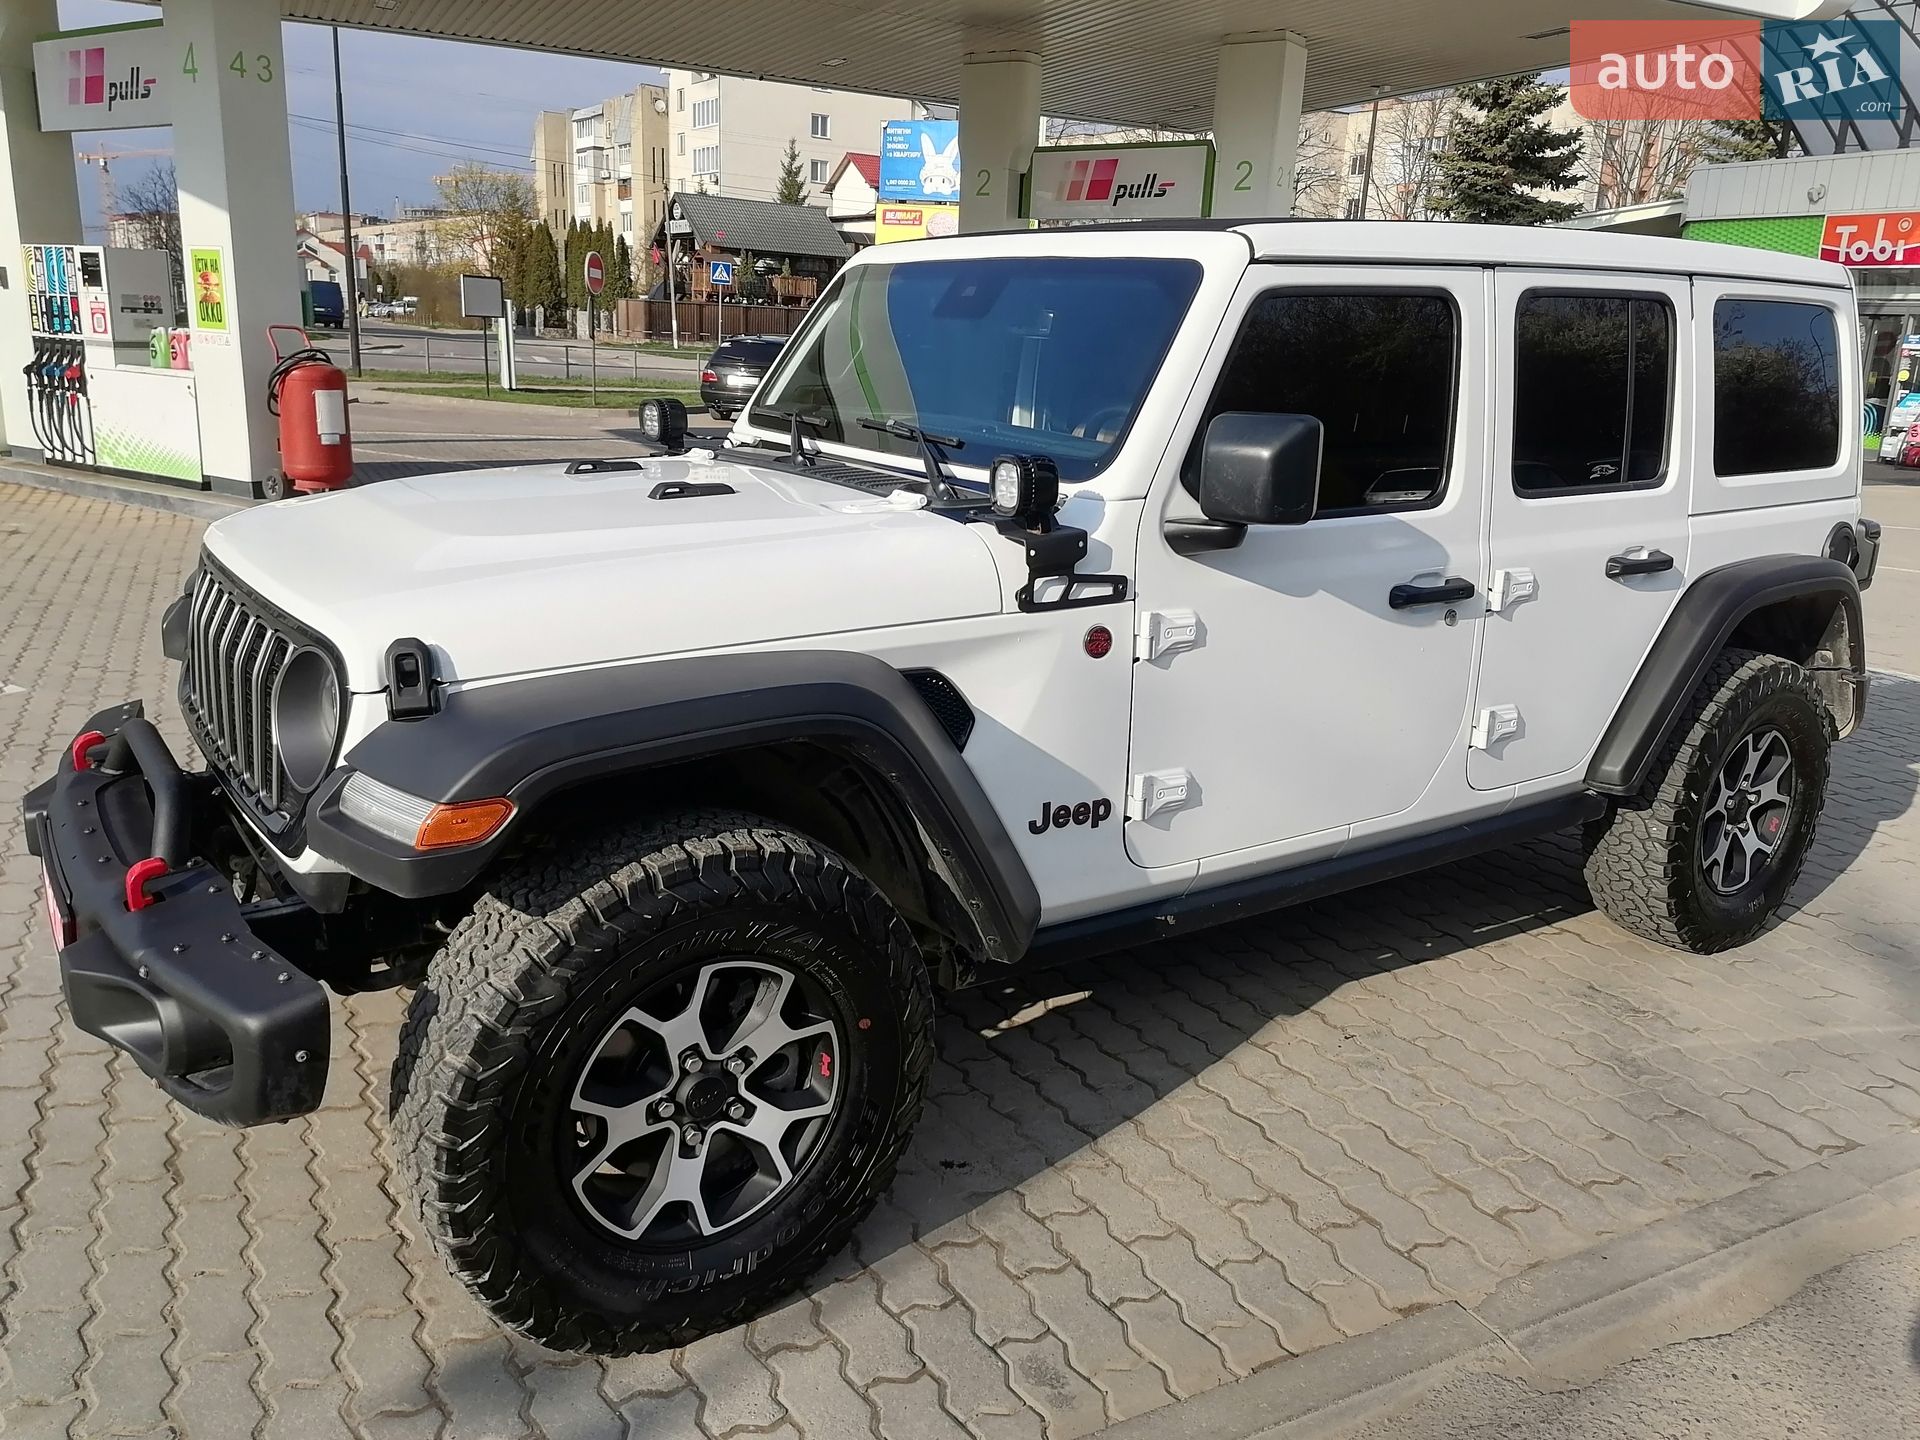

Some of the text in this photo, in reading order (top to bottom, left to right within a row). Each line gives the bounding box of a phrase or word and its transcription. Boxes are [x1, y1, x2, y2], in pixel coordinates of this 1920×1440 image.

[183, 42, 198, 83] 4
[229, 51, 273, 83] 4 3
[108, 66, 157, 112] pulls
[976, 169, 991, 196] 2
[1112, 174, 1176, 207] pulls
[1234, 160, 1253, 192] 2
[1835, 217, 1913, 263] Tobi
[1028, 797, 1112, 835] Jeep
